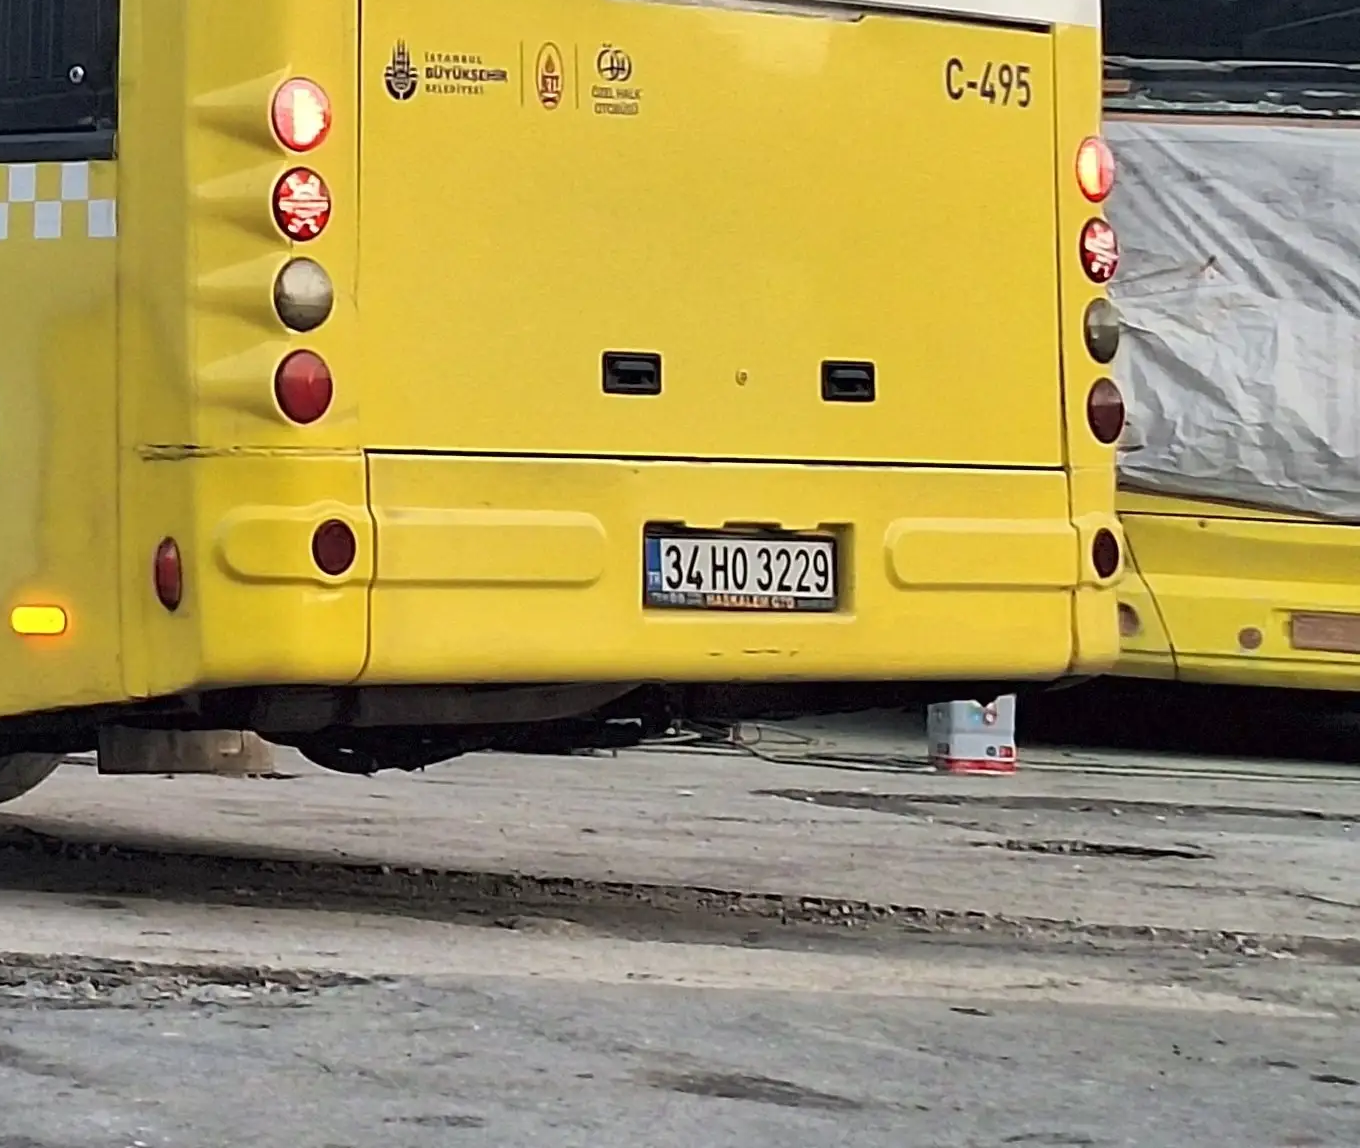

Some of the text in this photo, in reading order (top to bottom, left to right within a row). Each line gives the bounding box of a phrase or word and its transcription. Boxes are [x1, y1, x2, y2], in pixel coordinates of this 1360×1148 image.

[945, 57, 1032, 108] C-495
[665, 545, 829, 593] 34 HO 3229
